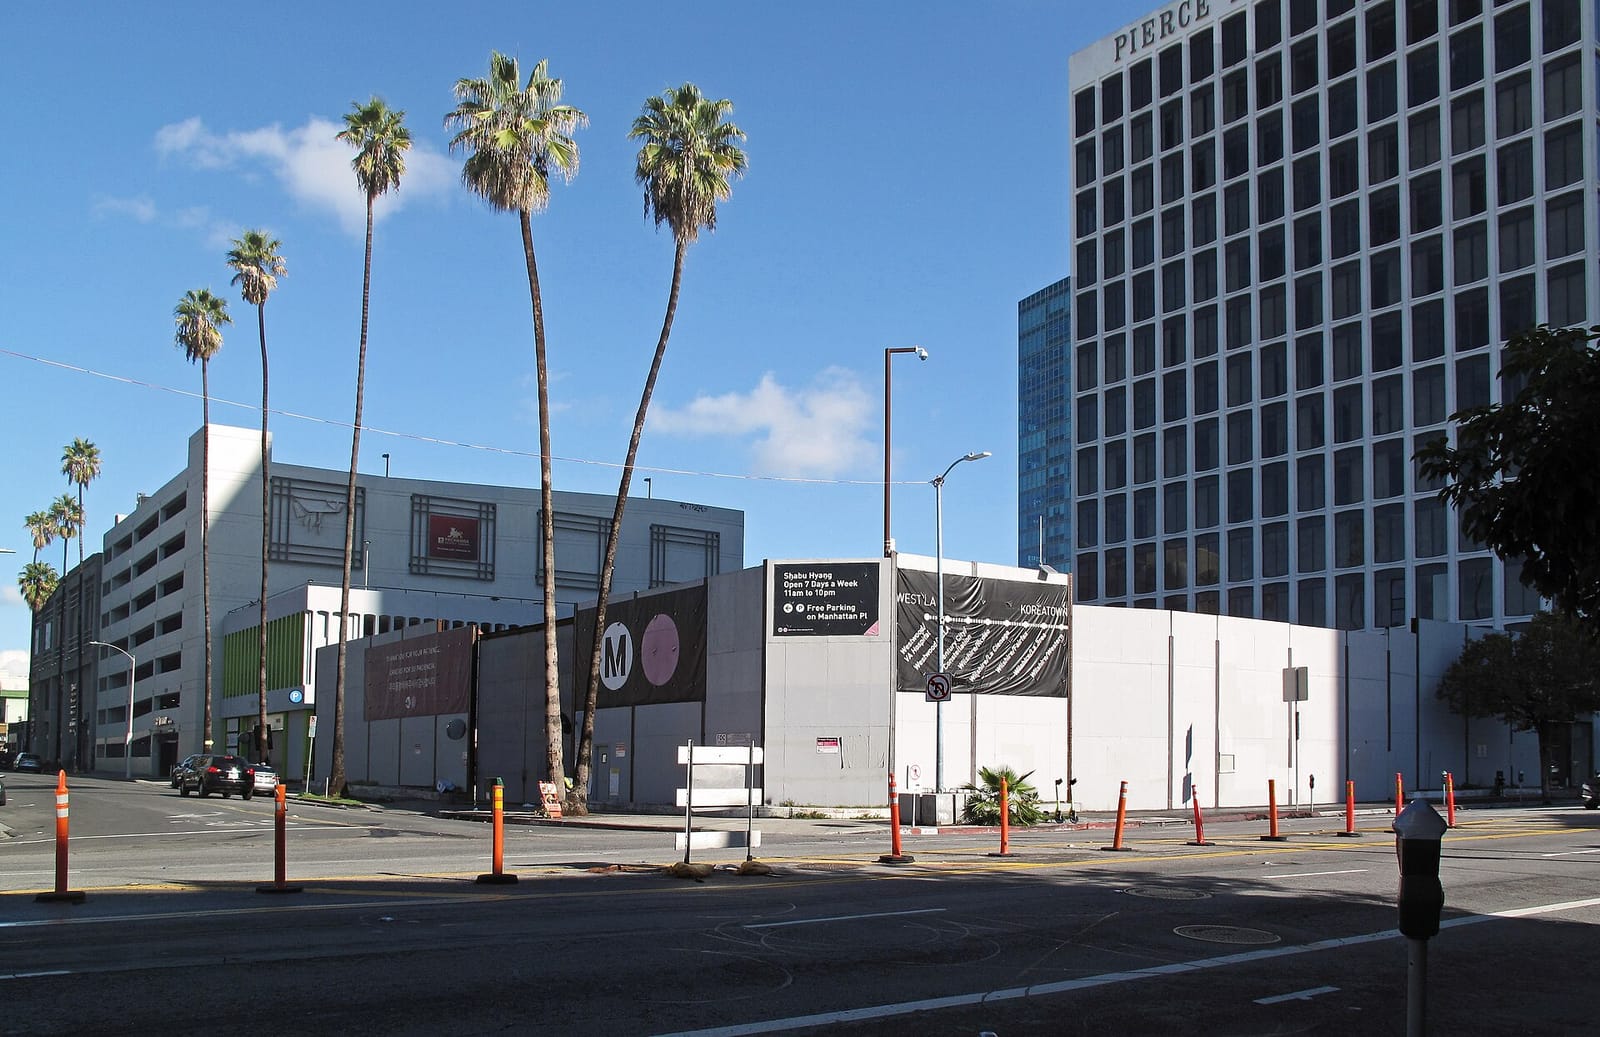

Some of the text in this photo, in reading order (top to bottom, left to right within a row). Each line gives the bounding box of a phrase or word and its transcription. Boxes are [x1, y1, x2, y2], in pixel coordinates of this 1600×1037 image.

[1114, 0, 1209, 62] PIERCE
[783, 572, 833, 580] Shabu Hyang
[783, 580, 803, 589] Open
[811, 580, 829, 588] Days
[783, 589, 804, 597] 11am
[815, 589, 836, 597] 10pm
[897, 593, 937, 607] WEST LA
[807, 604, 825, 612] Free
[826, 604, 856, 612] Parking
[1020, 603, 1068, 617] KOREATOWN
[818, 612, 858, 620] Manhattan
[605, 634, 626, 679] M
